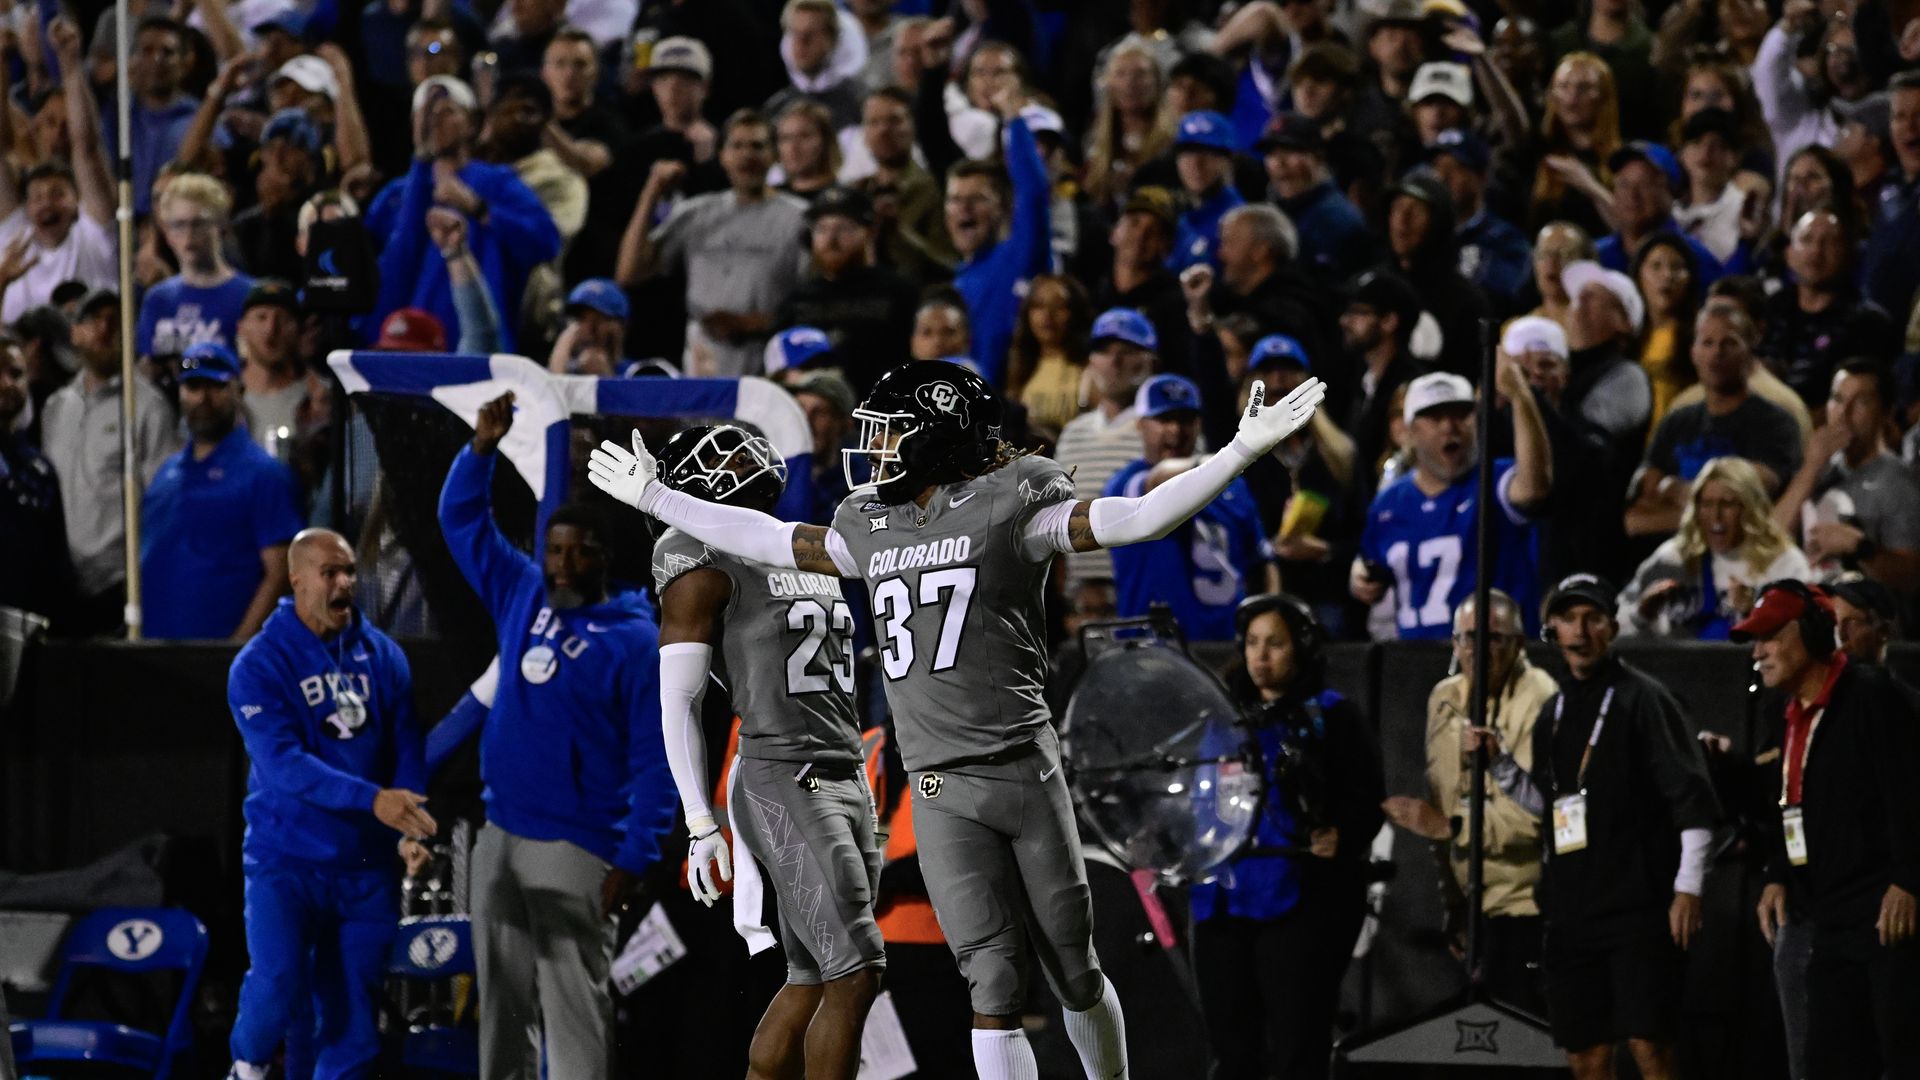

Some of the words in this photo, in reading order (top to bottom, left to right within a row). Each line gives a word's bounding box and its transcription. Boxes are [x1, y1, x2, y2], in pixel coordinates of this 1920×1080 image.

[931, 384, 960, 411] CU
[766, 572, 843, 599] COLORAD
[868, 535, 972, 579] COLORADO
[1386, 534, 1464, 630] 17
[785, 597, 856, 698] 23
[873, 564, 980, 683] 37
